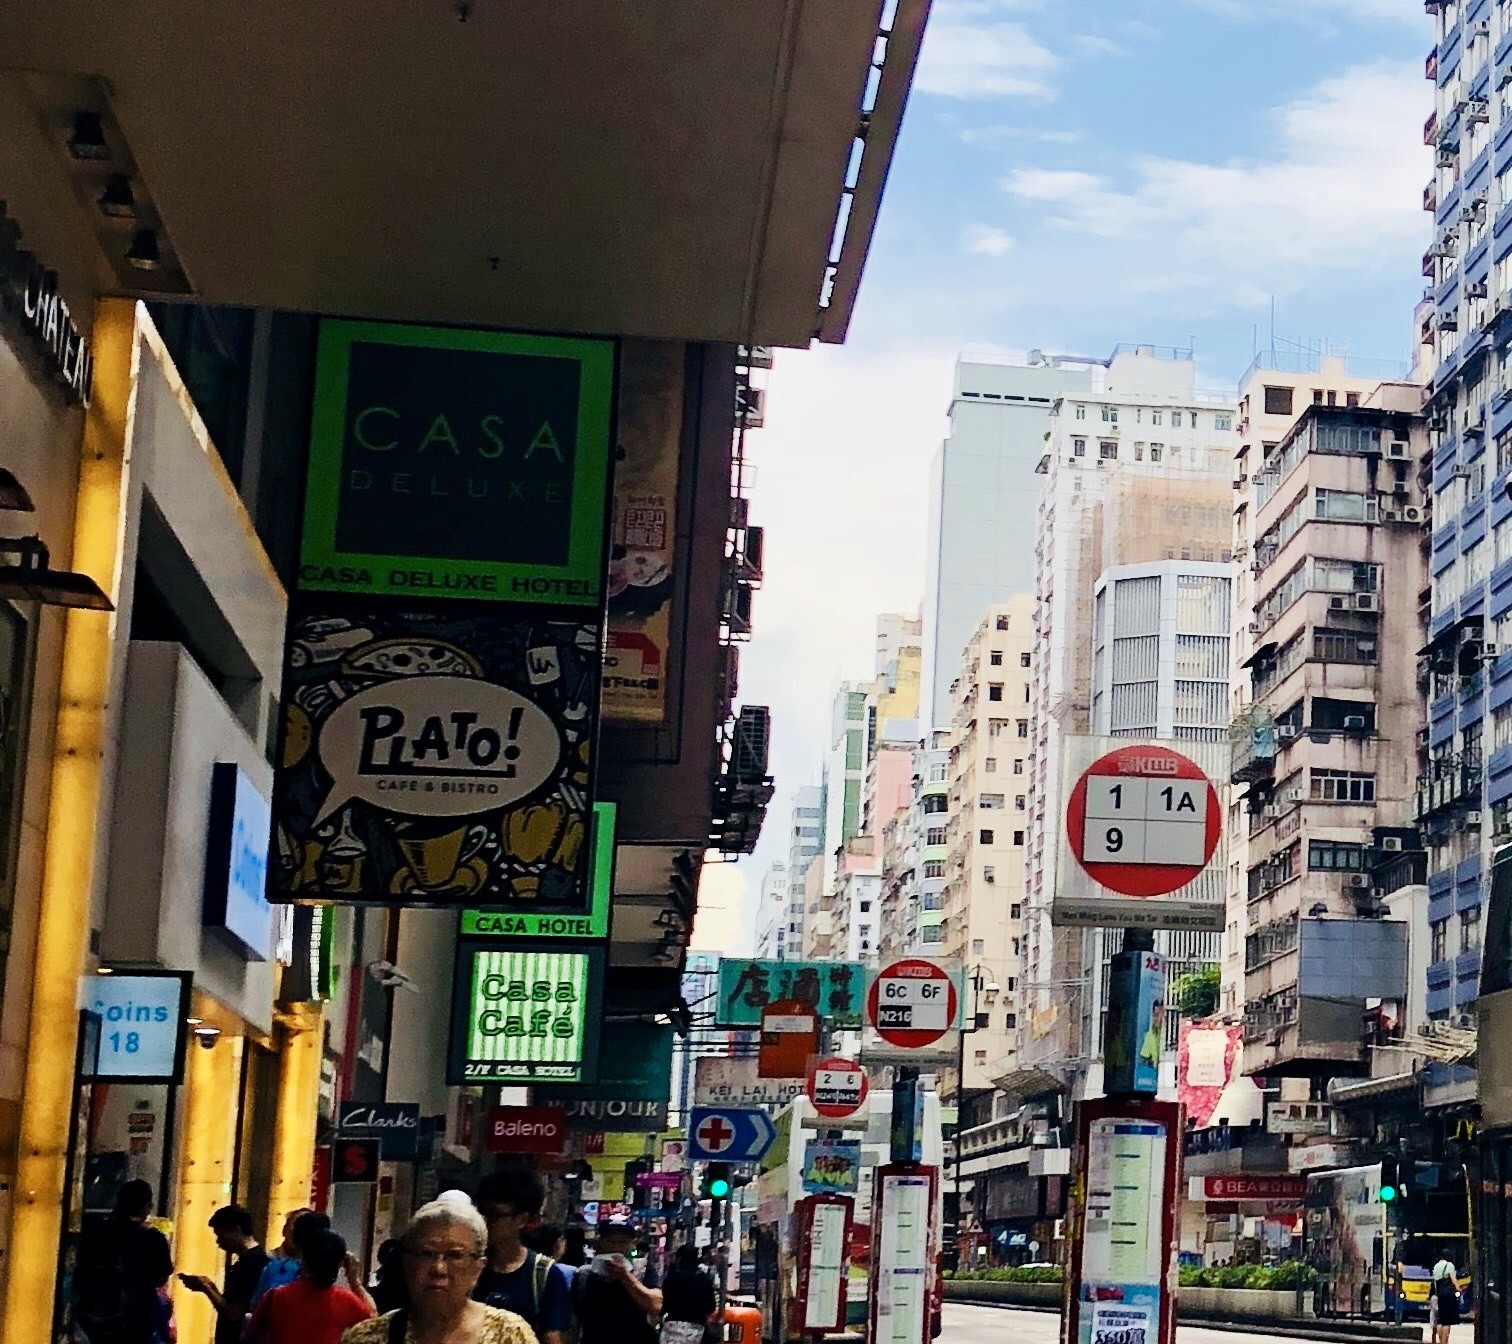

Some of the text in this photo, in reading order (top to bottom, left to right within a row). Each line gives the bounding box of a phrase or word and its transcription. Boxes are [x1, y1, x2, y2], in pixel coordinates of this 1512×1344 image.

[24, 284, 92, 409] CHATEAU
[354, 406, 565, 464] CASA
[350, 469, 564, 504] DELUXE
[300, 564, 600, 599] CASA DELUXE HOTEL
[376, 779, 418, 792] CAFE
[441, 782, 500, 795] BISTRO
[1109, 784, 1196, 813] 1 1A
[1105, 827, 1124, 853] 9
[475, 916, 594, 936] CASA HOTEL
[482, 973, 577, 1003] Casa
[885, 982, 941, 999] 6C 6F
[479, 1006, 575, 1038] Café
[880, 1006, 912, 1023] N216
[109, 1031, 140, 1053] 18
[709, 1086, 732, 1096] KEI
[743, 1085, 767, 1096] LAI
[342, 1107, 418, 1130] Clarks
[494, 1119, 557, 1137] Baleno
[1226, 1181, 1257, 1193] BEA
